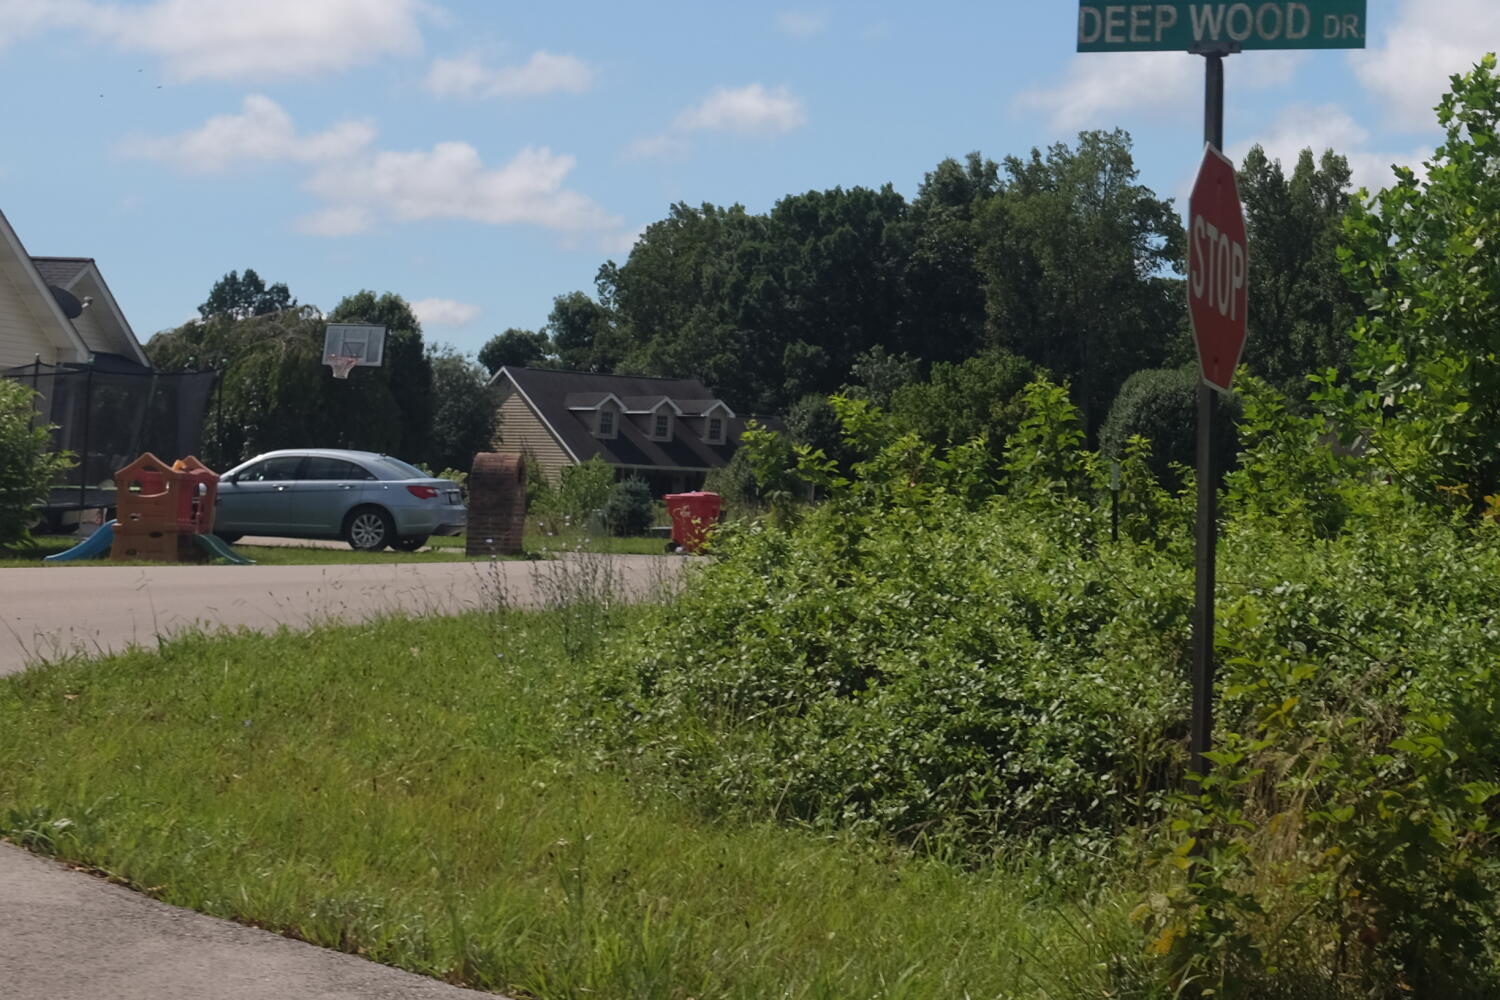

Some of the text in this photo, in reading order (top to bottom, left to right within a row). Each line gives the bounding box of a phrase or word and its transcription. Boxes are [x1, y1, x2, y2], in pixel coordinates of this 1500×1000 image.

[1079, 4, 1178, 43] DEEP
[1189, 2, 1311, 41] WOOD
[1192, 214, 1244, 321] STOP
